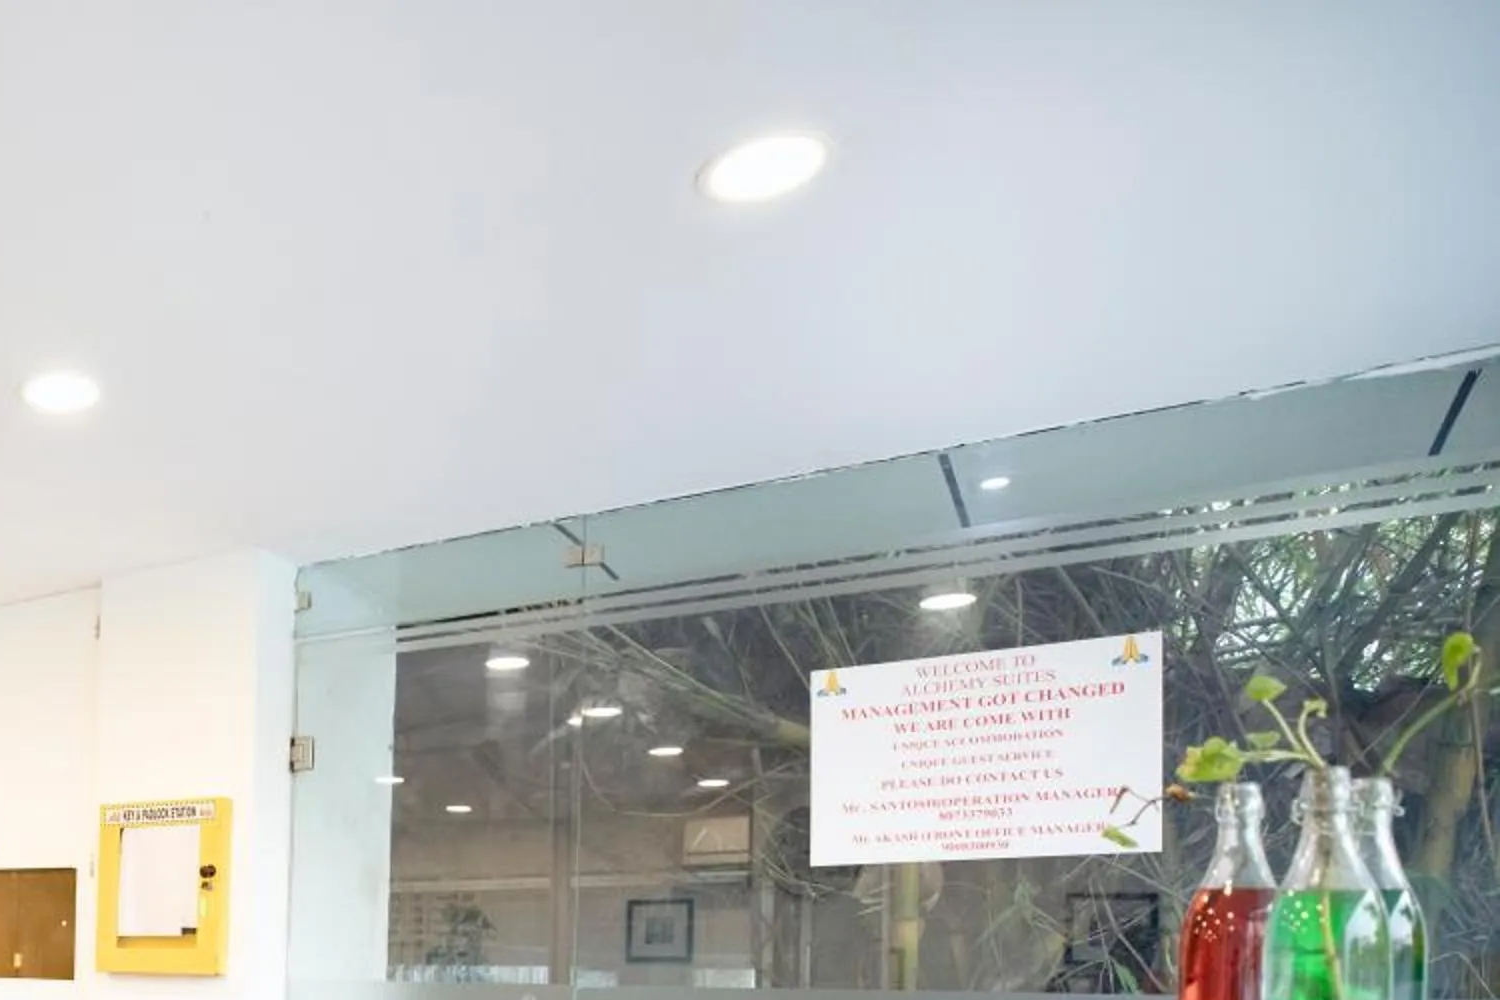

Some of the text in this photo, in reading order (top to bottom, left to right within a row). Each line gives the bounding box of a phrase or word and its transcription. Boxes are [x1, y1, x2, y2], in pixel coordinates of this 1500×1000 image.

[916, 655, 1036, 679] WELCOME TO
[902, 669, 1057, 697] ALCHEMY SUITES
[842, 681, 1126, 721] MANAGEMENT GOT CHANGED
[894, 707, 1071, 734] WE ARE COME WITH
[881, 777, 932, 791] PLEASE
[965, 770, 1038, 784] CONTACT
[1043, 768, 1064, 779] US
